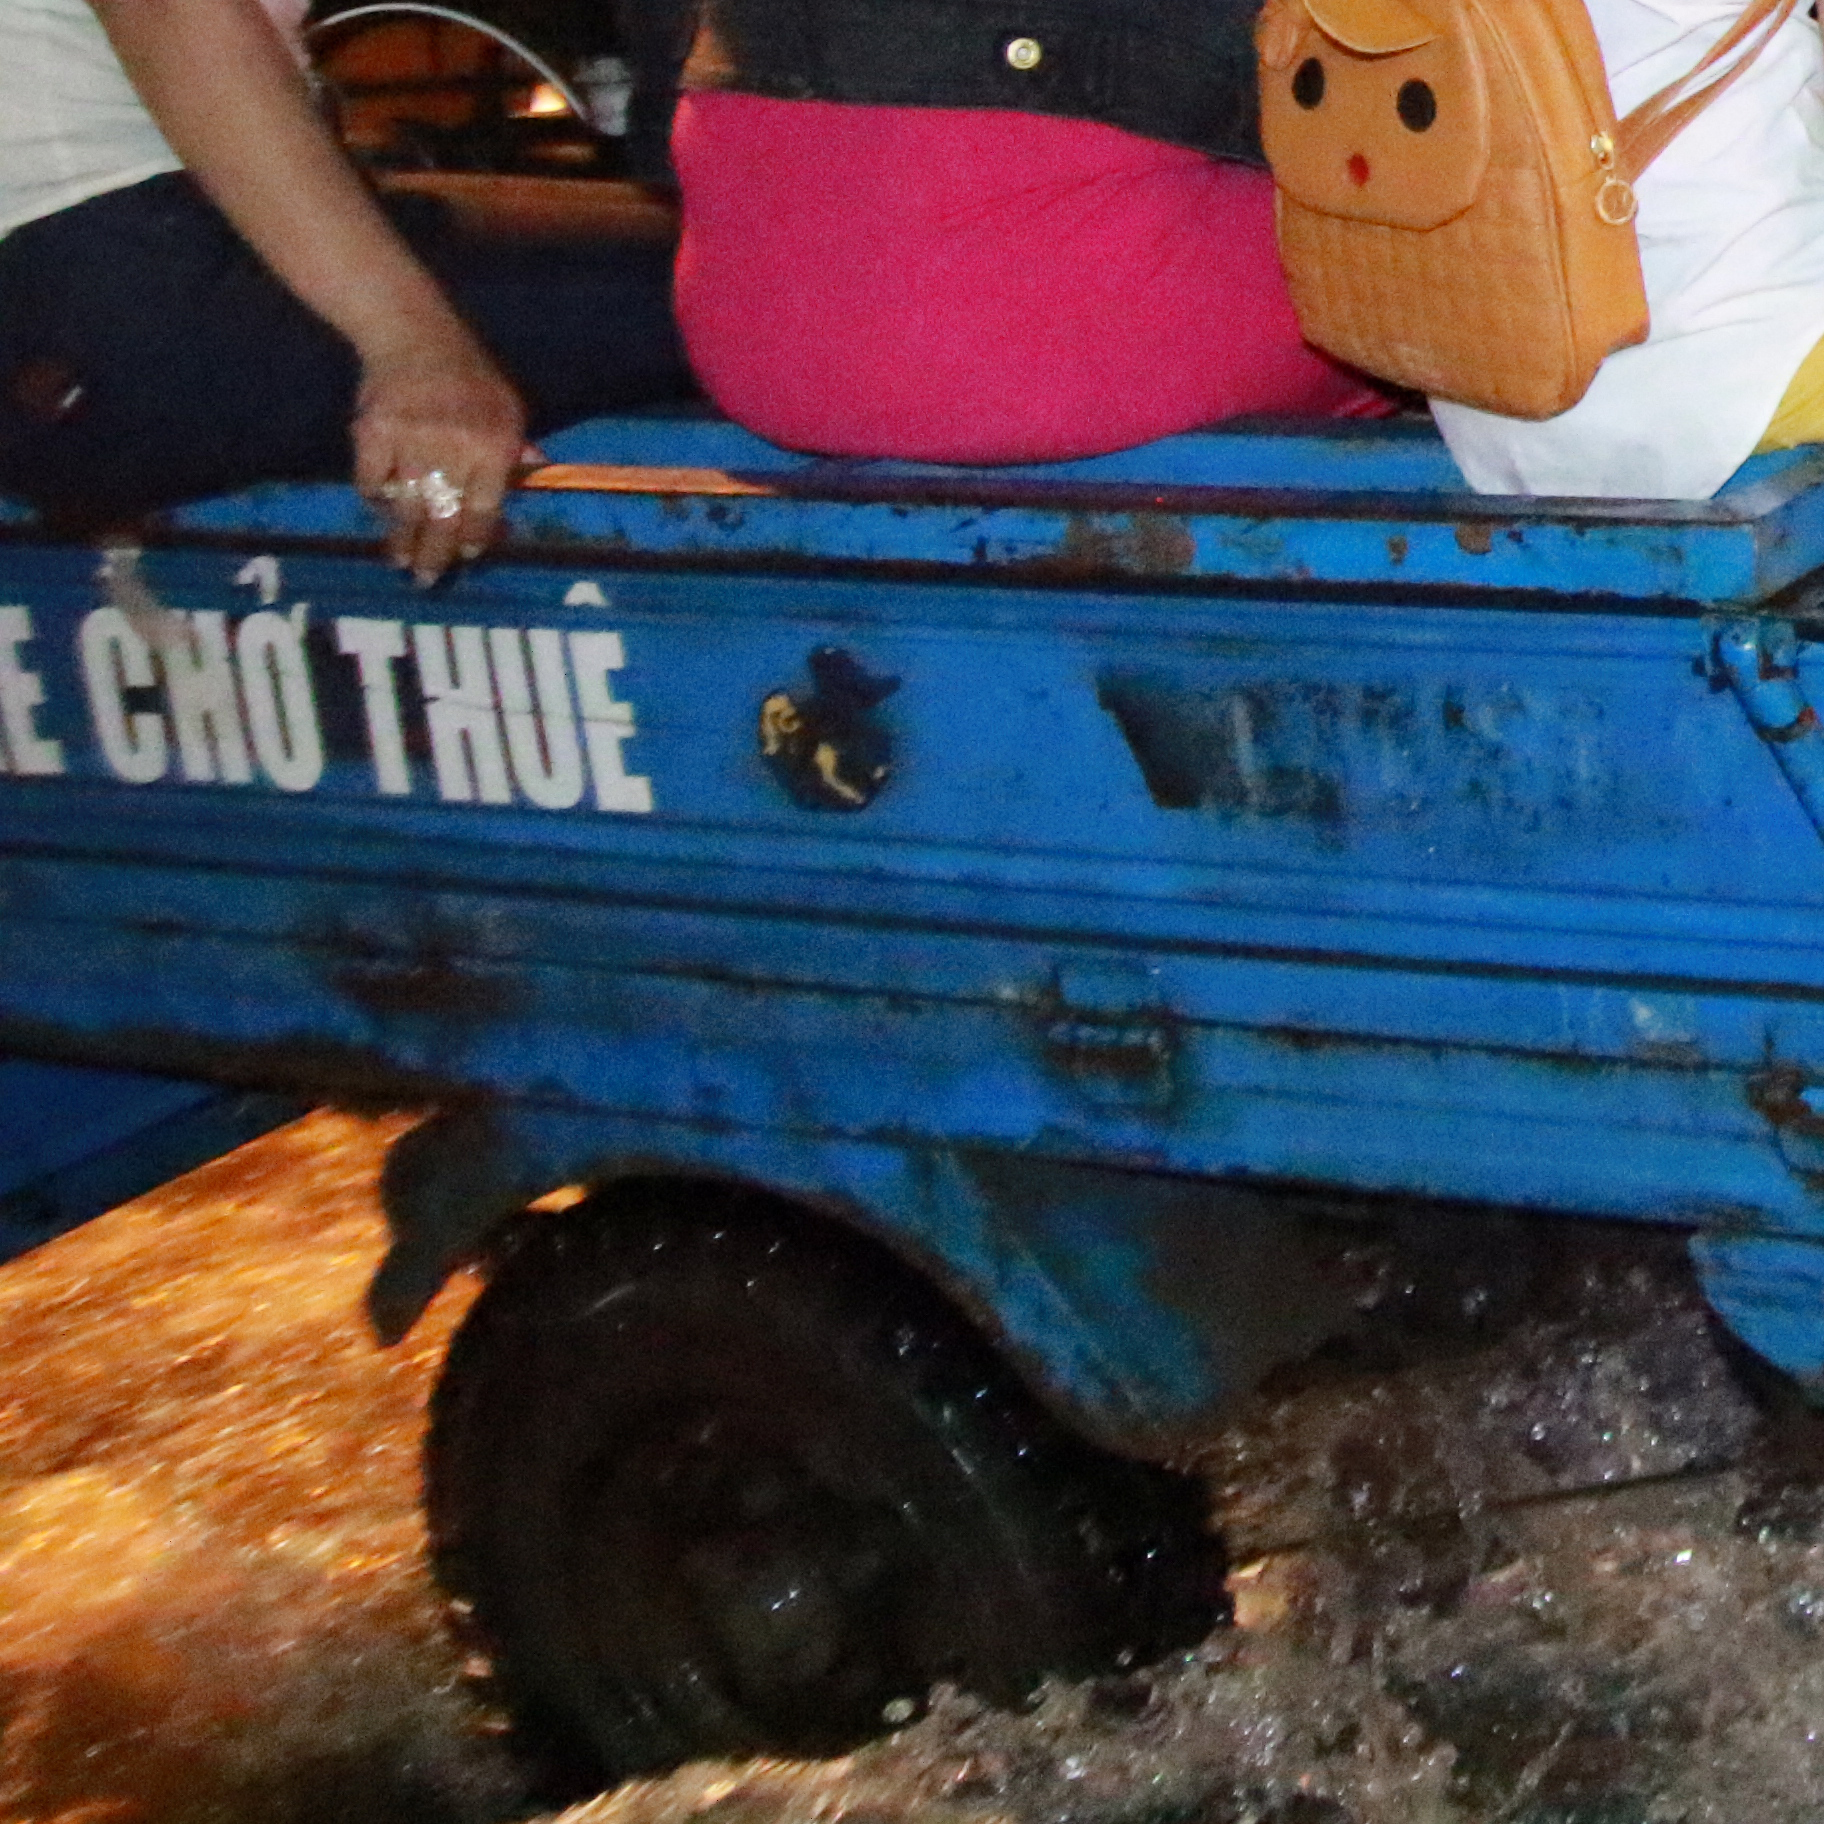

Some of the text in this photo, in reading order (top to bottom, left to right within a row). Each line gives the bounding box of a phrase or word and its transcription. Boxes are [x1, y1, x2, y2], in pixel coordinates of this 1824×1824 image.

[0, 555, 655, 814] E CHỞ THUÊ
